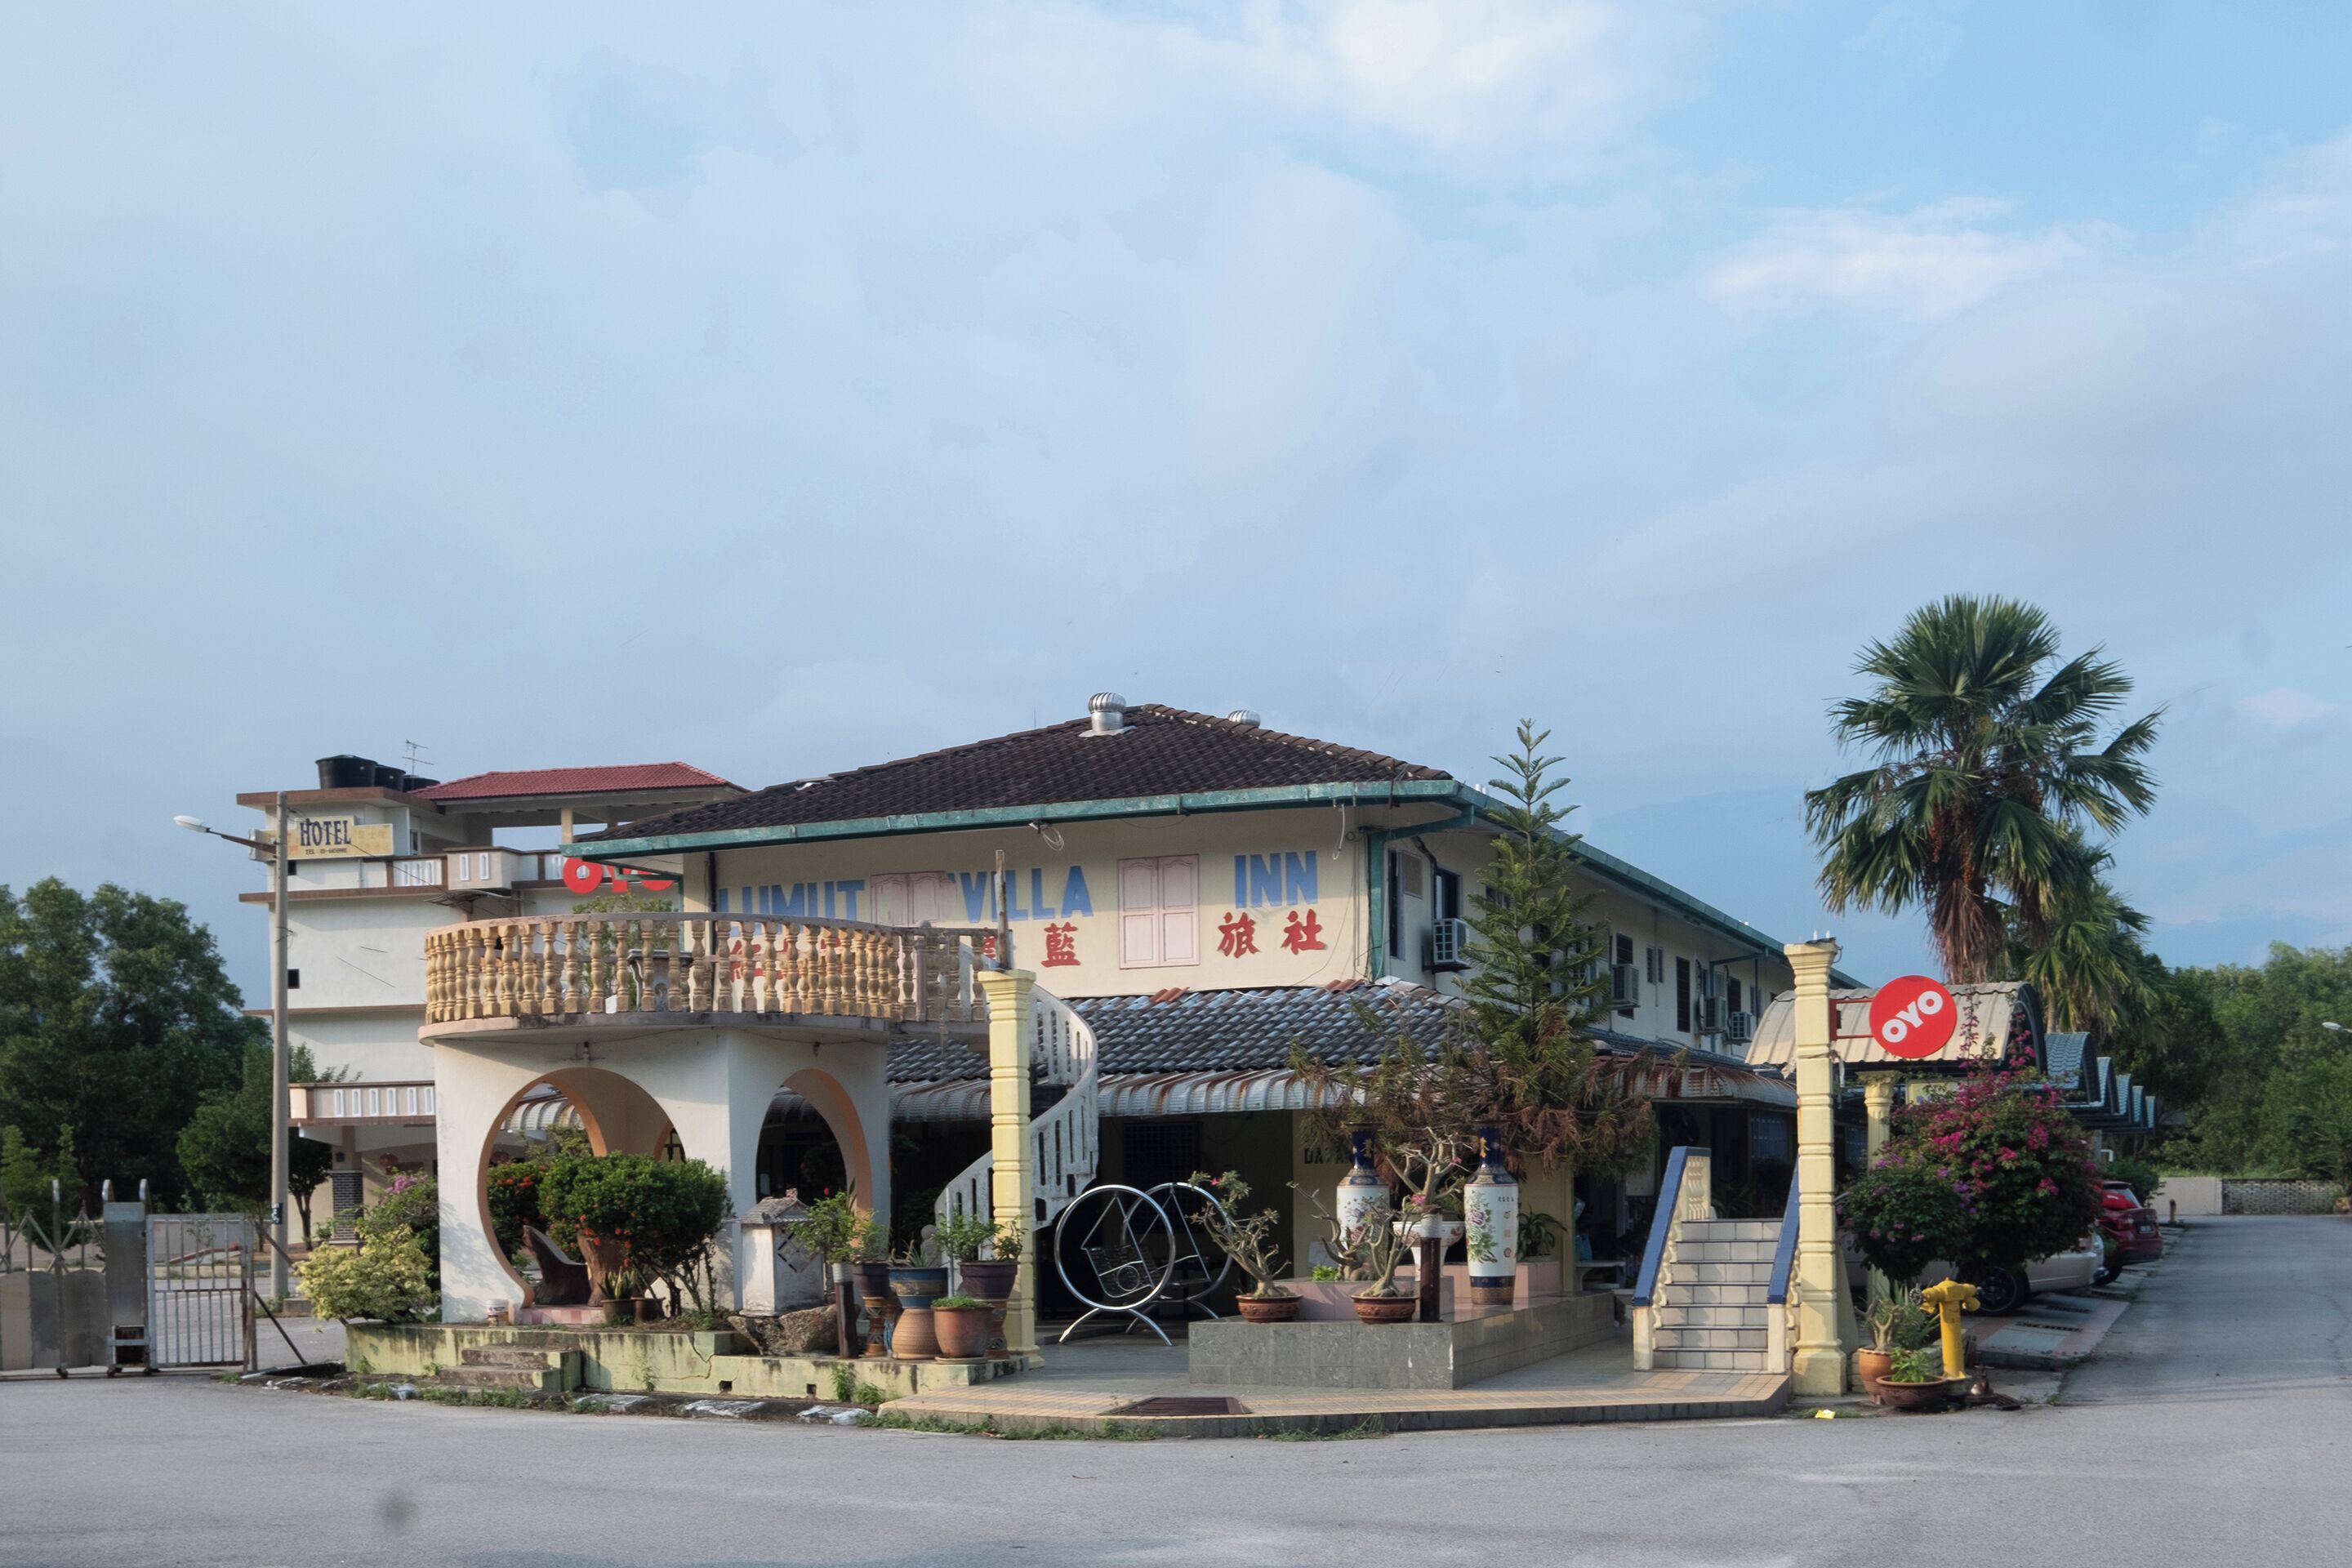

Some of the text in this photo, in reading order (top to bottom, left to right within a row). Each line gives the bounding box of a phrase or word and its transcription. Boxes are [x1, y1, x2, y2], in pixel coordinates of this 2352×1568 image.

[300, 820, 351, 846] HOTEL
[718, 850, 1318, 937] LUMUT VILLA INN
[1217, 909, 1326, 958] 旅社
[1882, 991, 1943, 1043] OYO
